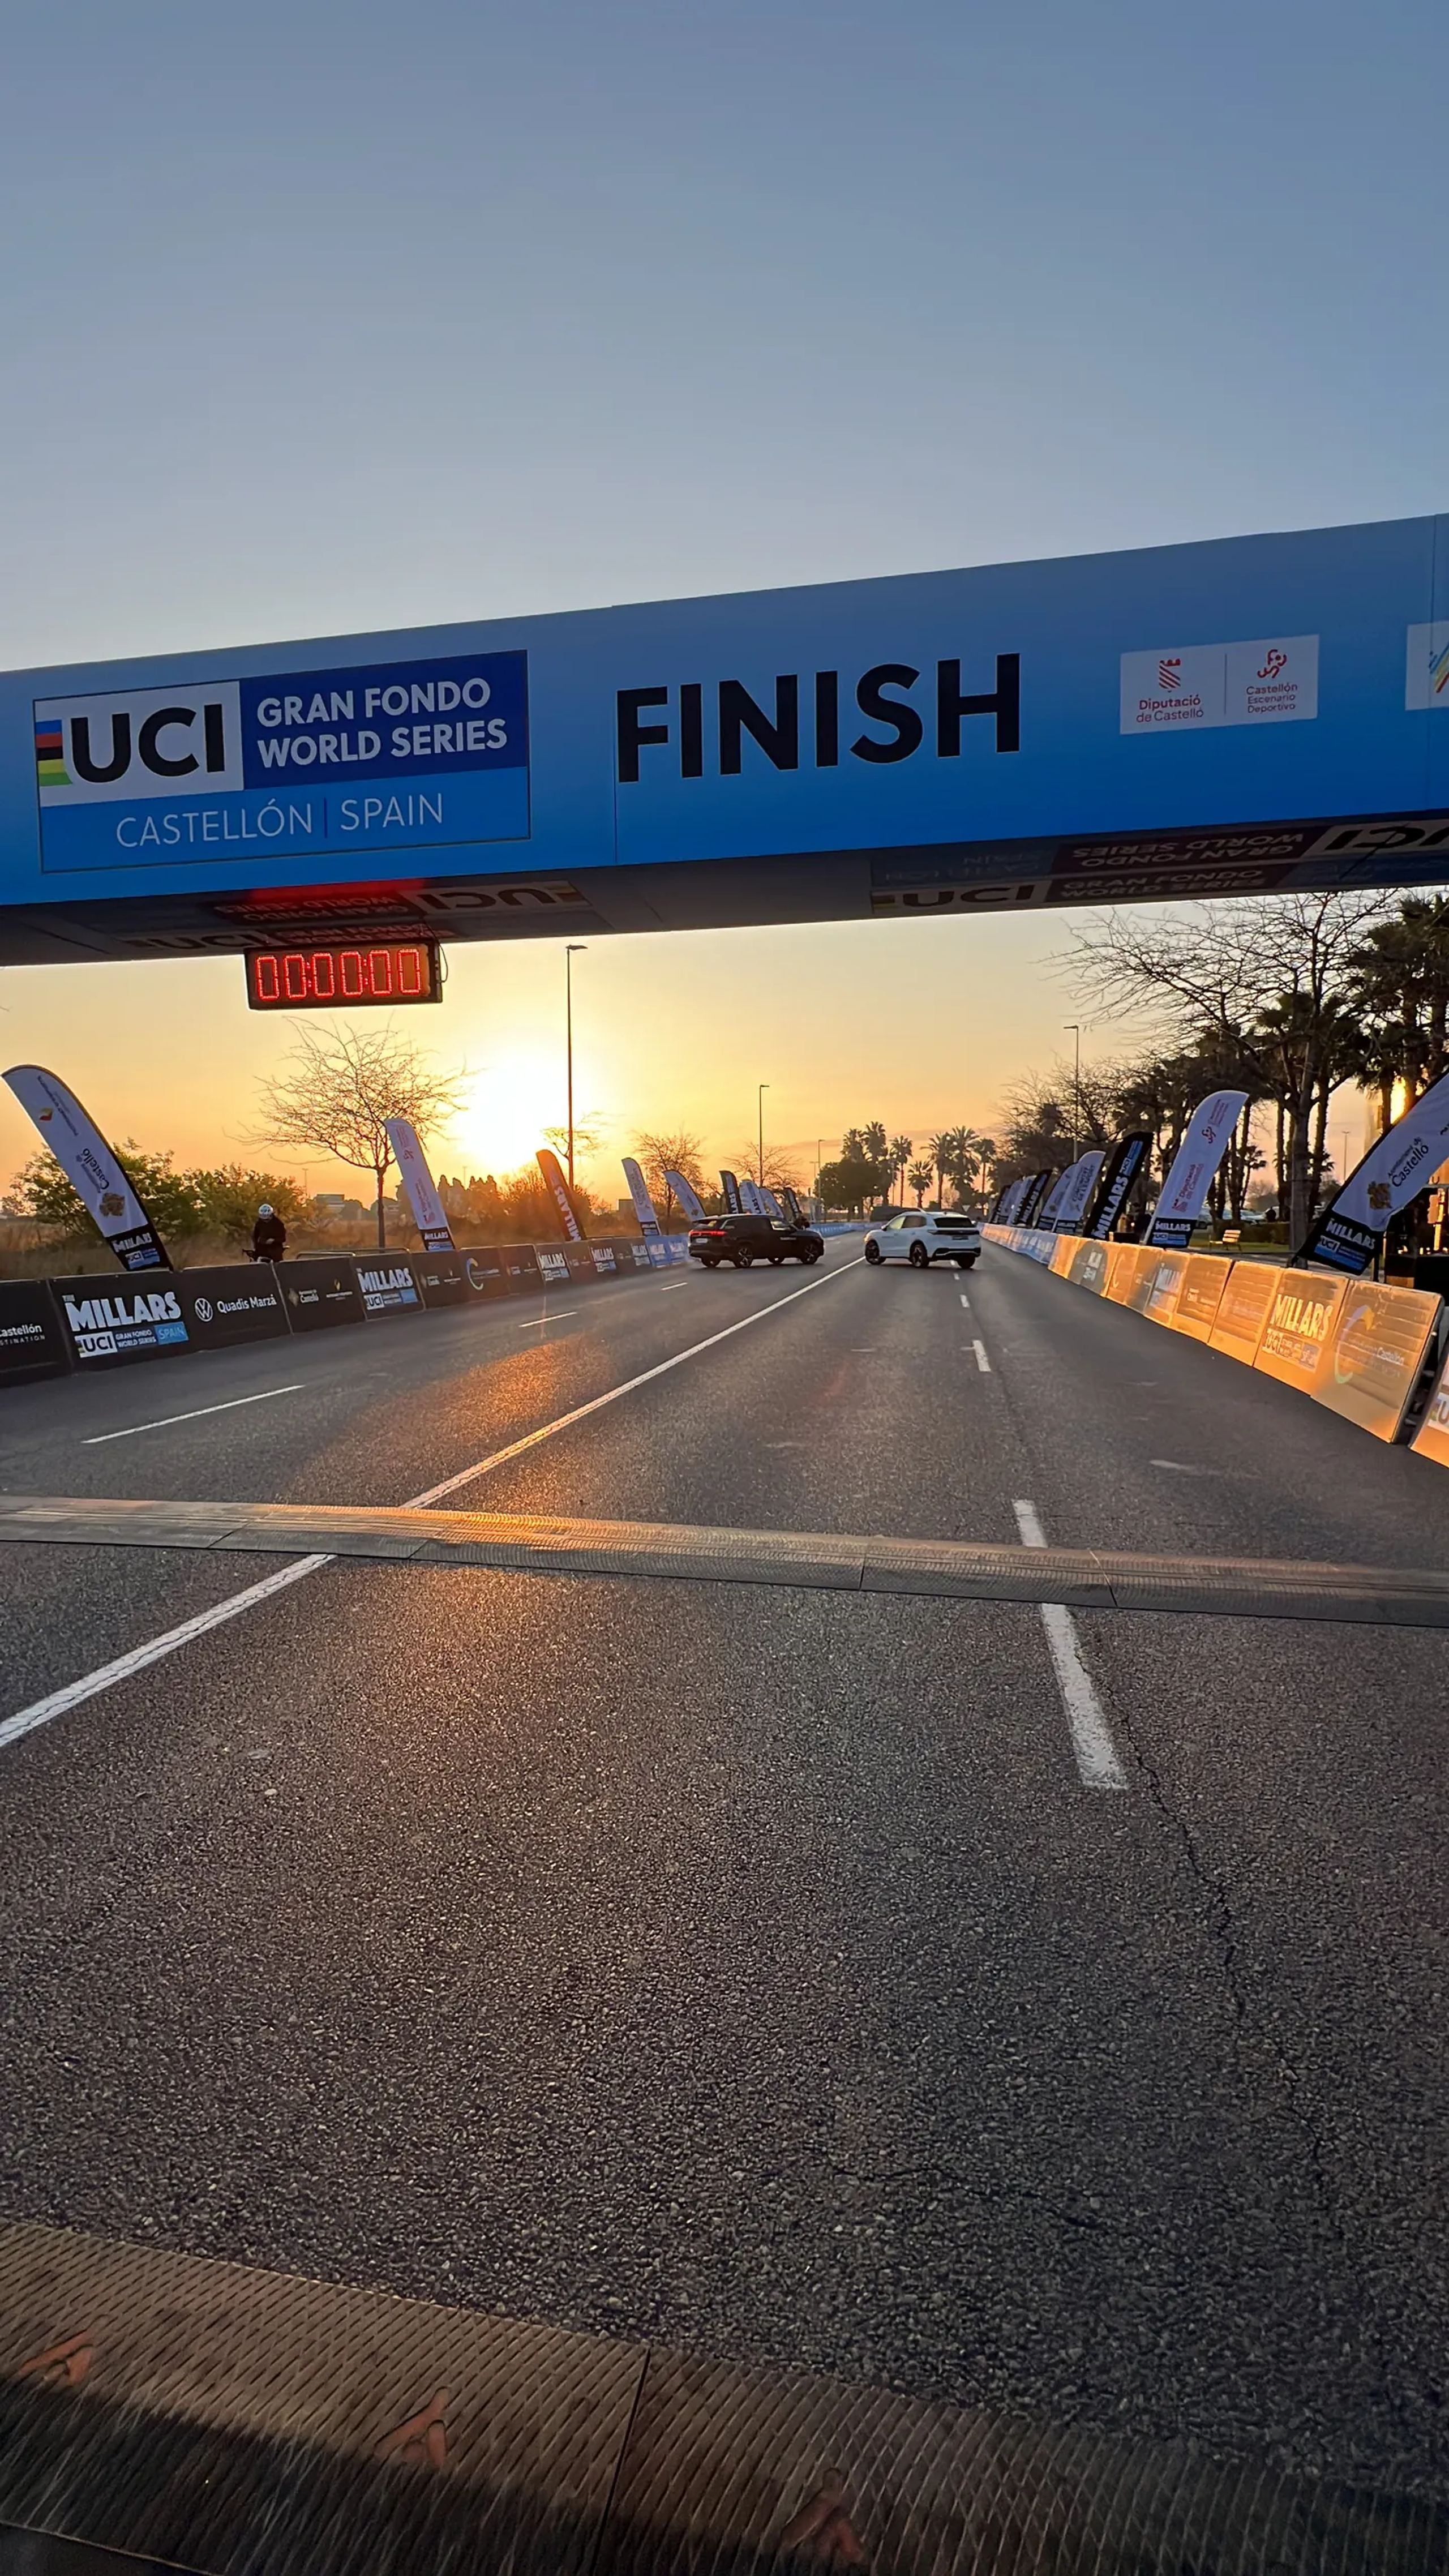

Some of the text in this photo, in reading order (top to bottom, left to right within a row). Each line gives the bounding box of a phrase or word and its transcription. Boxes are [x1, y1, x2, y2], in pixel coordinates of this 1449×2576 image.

[1246, 682, 1298, 696] Castellón
[1247, 693, 1296, 705] Escenario
[256, 677, 491, 727] GRAN FONDO
[1139, 694, 1201, 711] Diputació
[1247, 703, 1296, 714] Deportivo
[617, 653, 1020, 783] FINISH
[1136, 711, 1152, 723] de
[70, 704, 225, 783] UCI
[257, 718, 508, 768] WORLD SERIES
[116, 793, 443, 847] CASTELLÓN SPAIN
[1073, 834, 1304, 857] WORLD SERIES
[1081, 851, 1192, 867] FONDO
[417, 888, 556, 910] UCI
[903, 885, 1035, 906] UCI
[149, 935, 266, 949] UCI
[1094, 1176, 1129, 1239] MILLARS
[1326, 1221, 1375, 1250] MILLARS
[357, 1268, 413, 1293] MILLARS
[65, 1292, 181, 1331] MILLARS
[217, 1294, 277, 1314] Quadis Marzá
[1270, 1294, 1334, 1341] MILLARS
[0, 1323, 42, 1337] astellón
[158, 1326, 186, 1339] SPAIN
[83, 1335, 113, 1352] UCI
